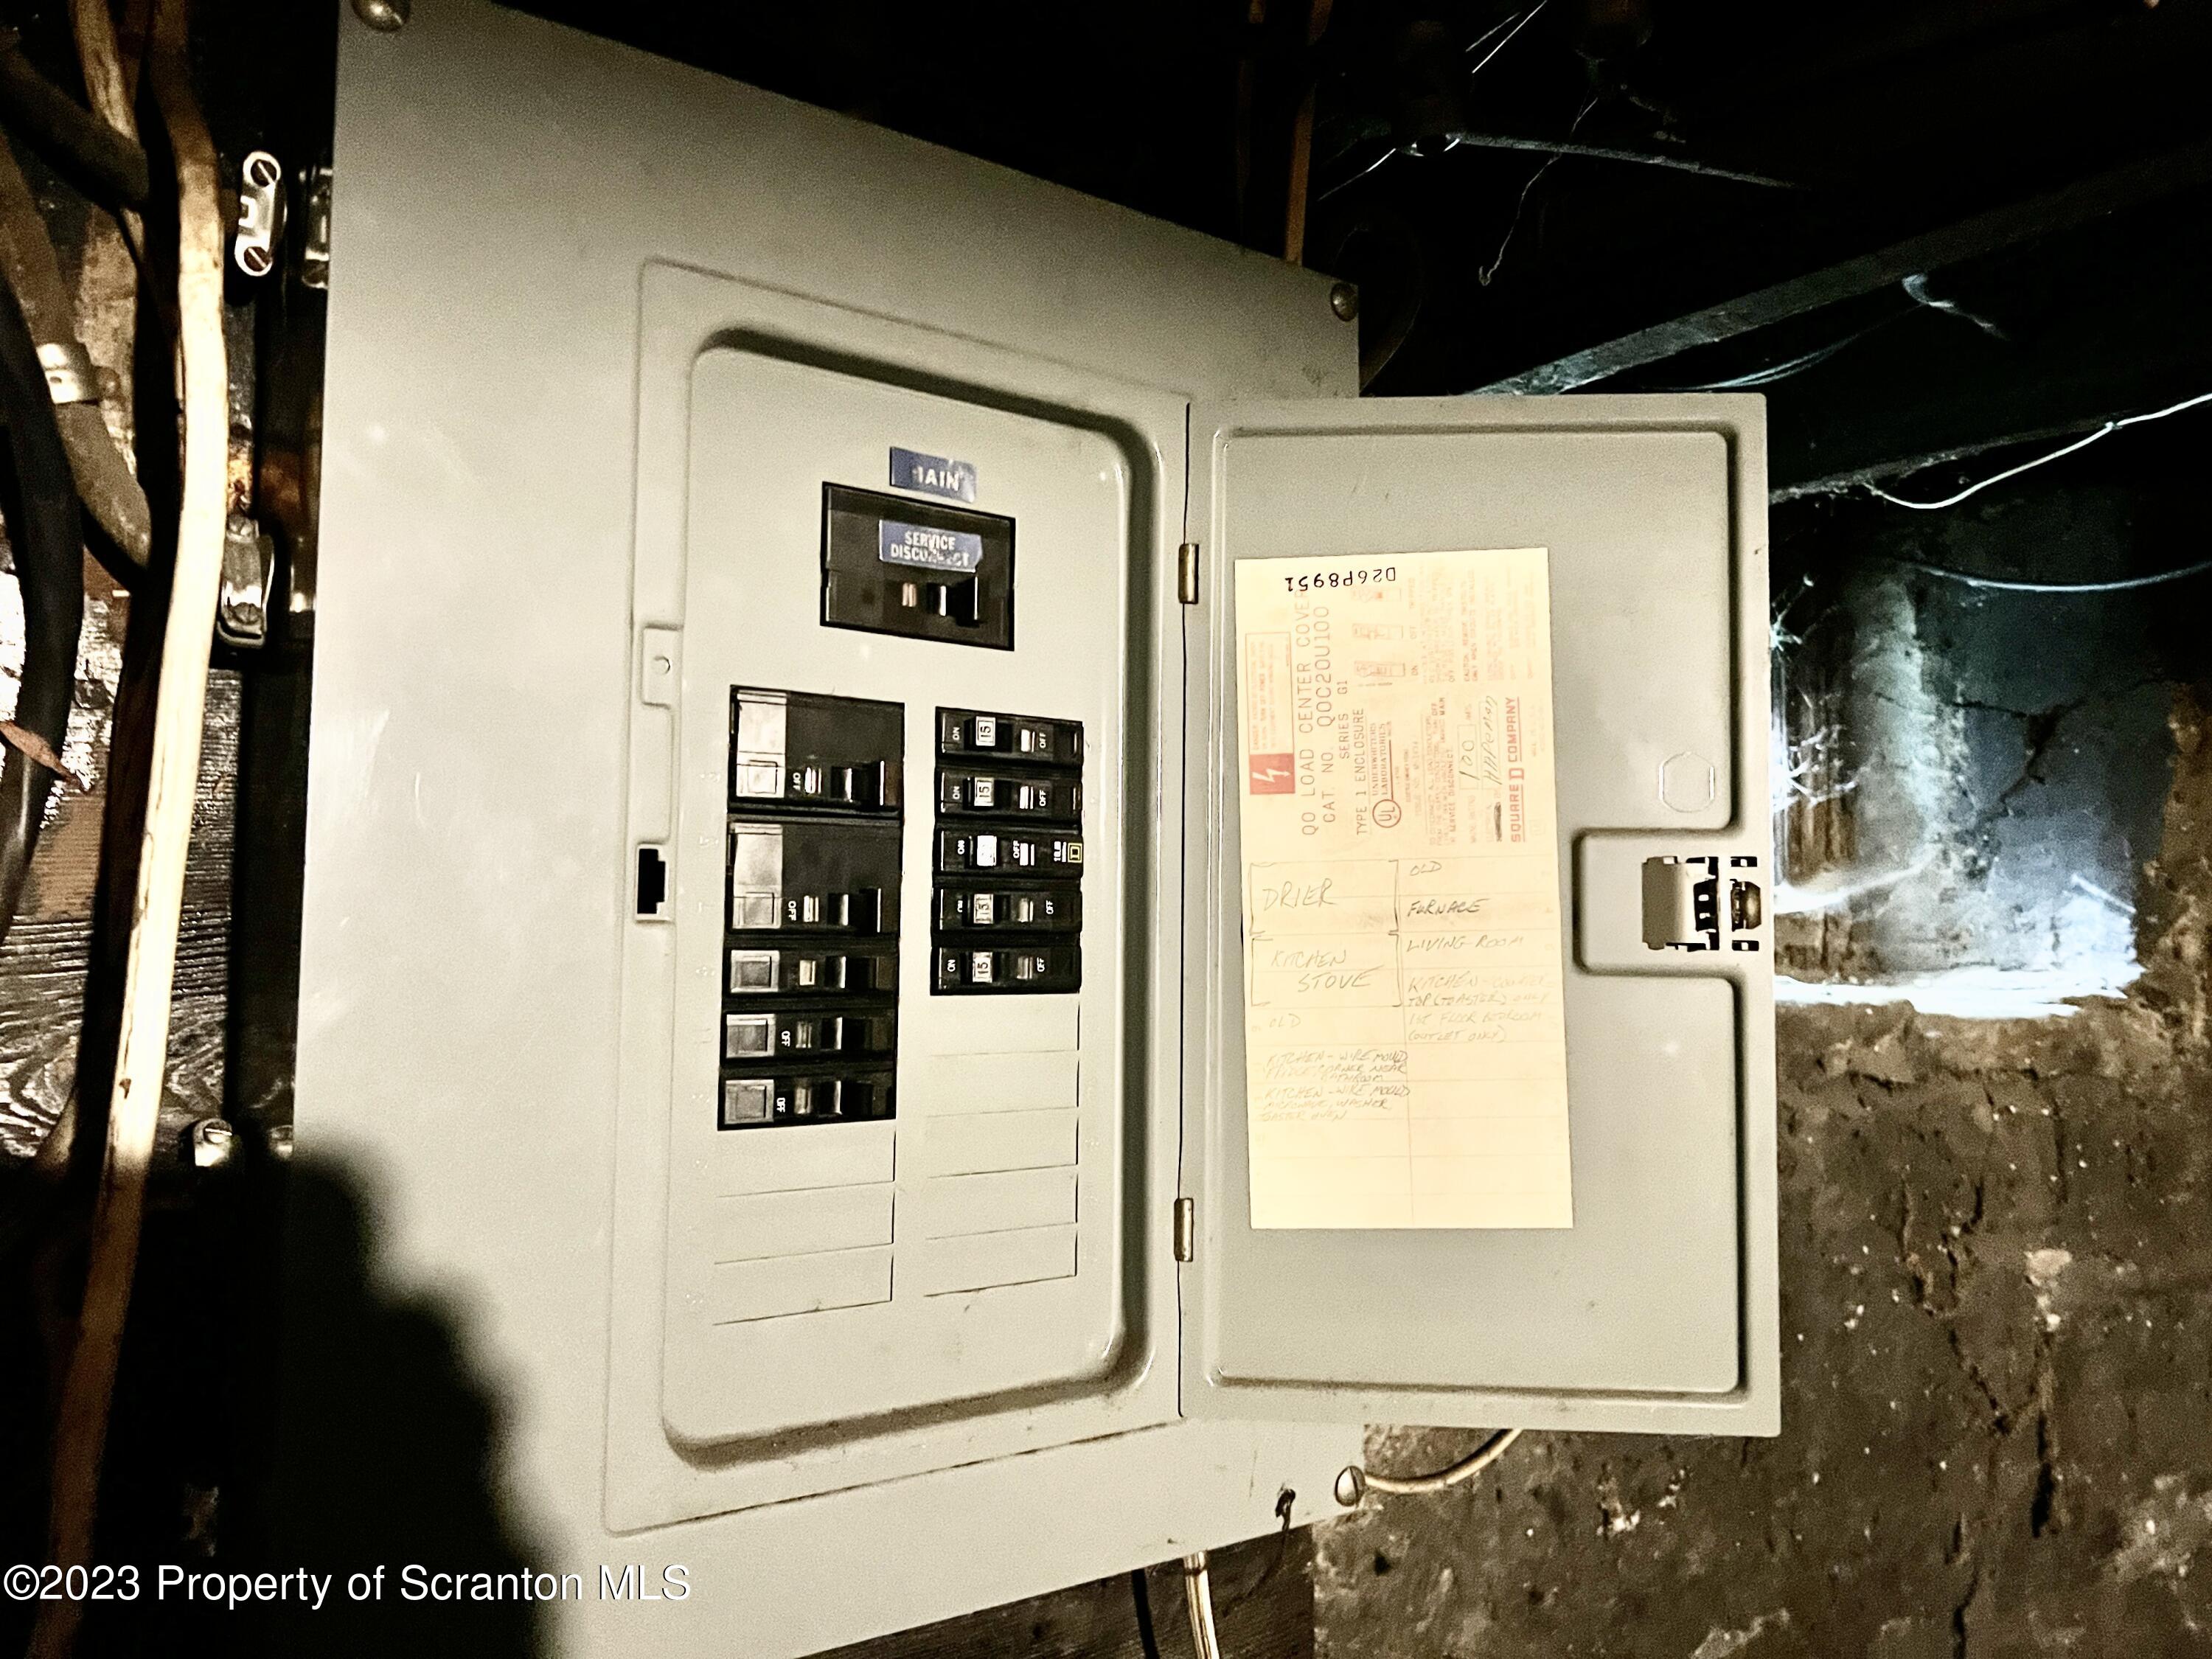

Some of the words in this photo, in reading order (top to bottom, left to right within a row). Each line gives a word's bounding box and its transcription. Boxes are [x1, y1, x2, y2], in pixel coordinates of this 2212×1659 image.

[905, 530, 956, 551] SERVICE
[891, 543, 970, 567] DISCOCT
[1295, 588, 1310, 647] COVER
[1296, 663, 1313, 734] CENTER
[953, 727, 960, 740] ON
[980, 726, 992, 737] 15
[1338, 713, 1350, 759] SERIES
[1505, 697, 1517, 762] COMPANY
[1352, 708, 1366, 782] ENCLOSURE
[1299, 748, 1315, 797] LOAD
[953, 786, 960, 799] ON
[979, 786, 990, 798] 15
[1356, 807, 1367, 835] TYPE
[1509, 785, 1521, 843] SQUARE
[957, 840, 965, 855] ON
[1012, 840, 1020, 859] OFF
[1262, 878, 1337, 910] DRIER
[787, 900, 796, 921] OFF
[1046, 900, 1054, 915] OFF
[1407, 936, 1466, 952] LIVING
[1475, 934, 1524, 949] ROOM
[947, 959, 956, 973] ON
[977, 961, 989, 974] 15
[1037, 957, 1045, 973] OFF
[1270, 949, 1346, 969] KITCHEN
[1298, 965, 1384, 992] STOVE
[1408, 970, 1478, 992] KITCHEN
[782, 1030, 791, 1047] OFF
